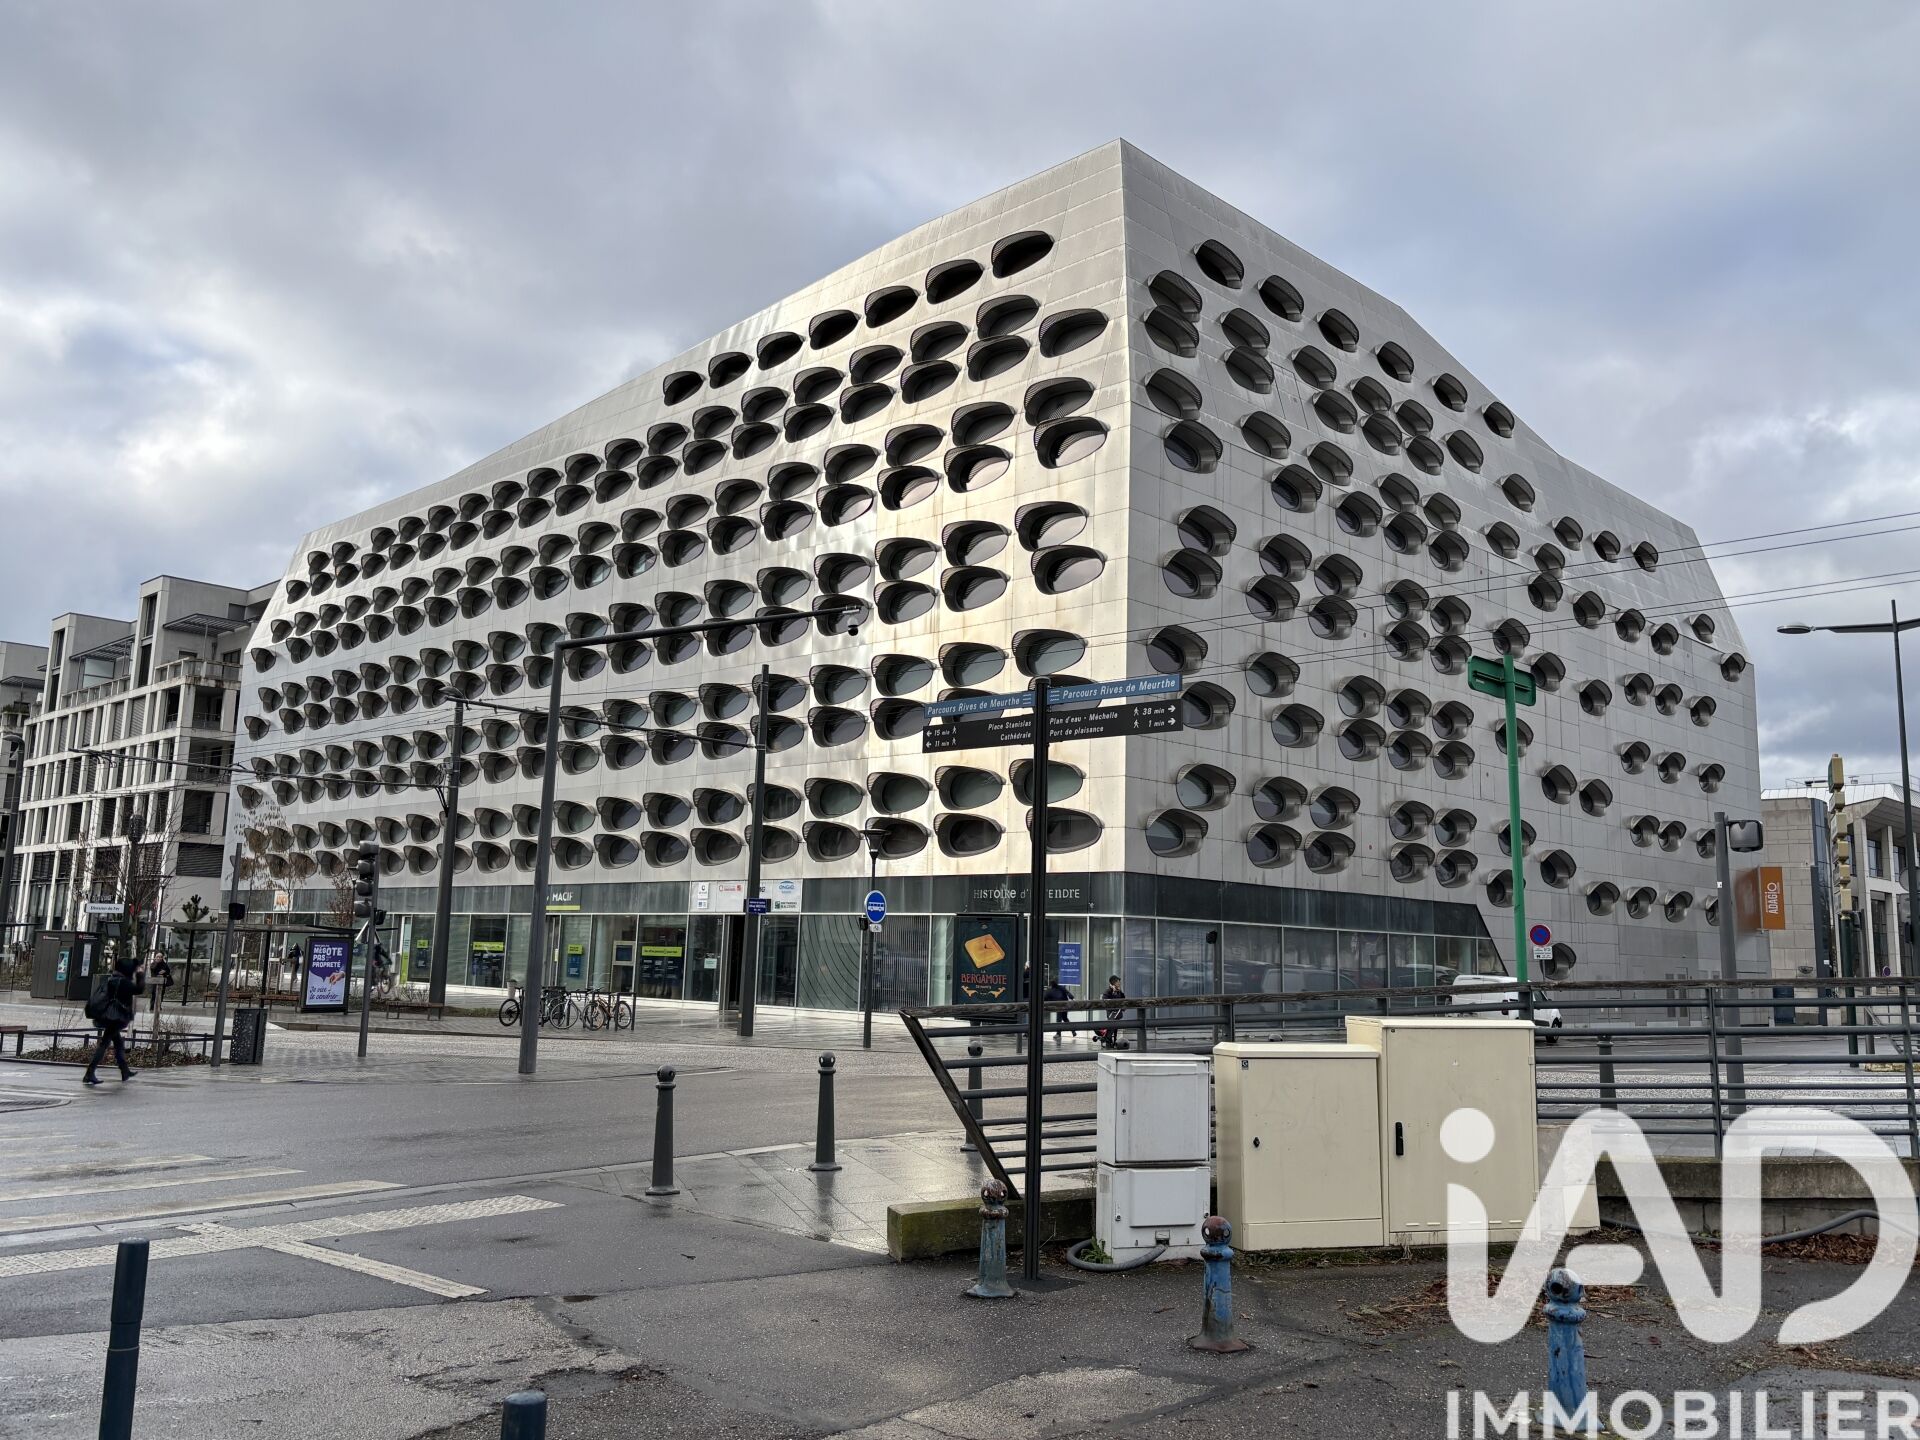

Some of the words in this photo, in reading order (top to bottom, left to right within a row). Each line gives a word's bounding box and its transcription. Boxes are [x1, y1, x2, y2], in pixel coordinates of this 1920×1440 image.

[1062, 689, 1098, 699] Parcours
[1100, 685, 1123, 695] Rives
[1125, 683, 1136, 693] de
[1139, 679, 1176, 691] Meurthe
[927, 705, 956, 715] Parcours
[958, 702, 977, 712] Rives
[979, 700, 988, 709] de
[989, 697, 1020, 708] Meurthe
[1142, 707, 1152, 716] 38
[987, 723, 1004, 731] Place
[1005, 720, 1032, 729] Stanislas
[1049, 717, 1064, 725] Plan
[1065, 716, 1082, 724] d'eau
[1000, 731, 1032, 741] Cathédrale
[1049, 729, 1063, 737] Port
[1074, 726, 1104, 736] plaisance
[552, 892, 574, 902] MACIF
[312, 954, 326, 962] PAS
[960, 973, 1007, 985] BERGAMOTE
